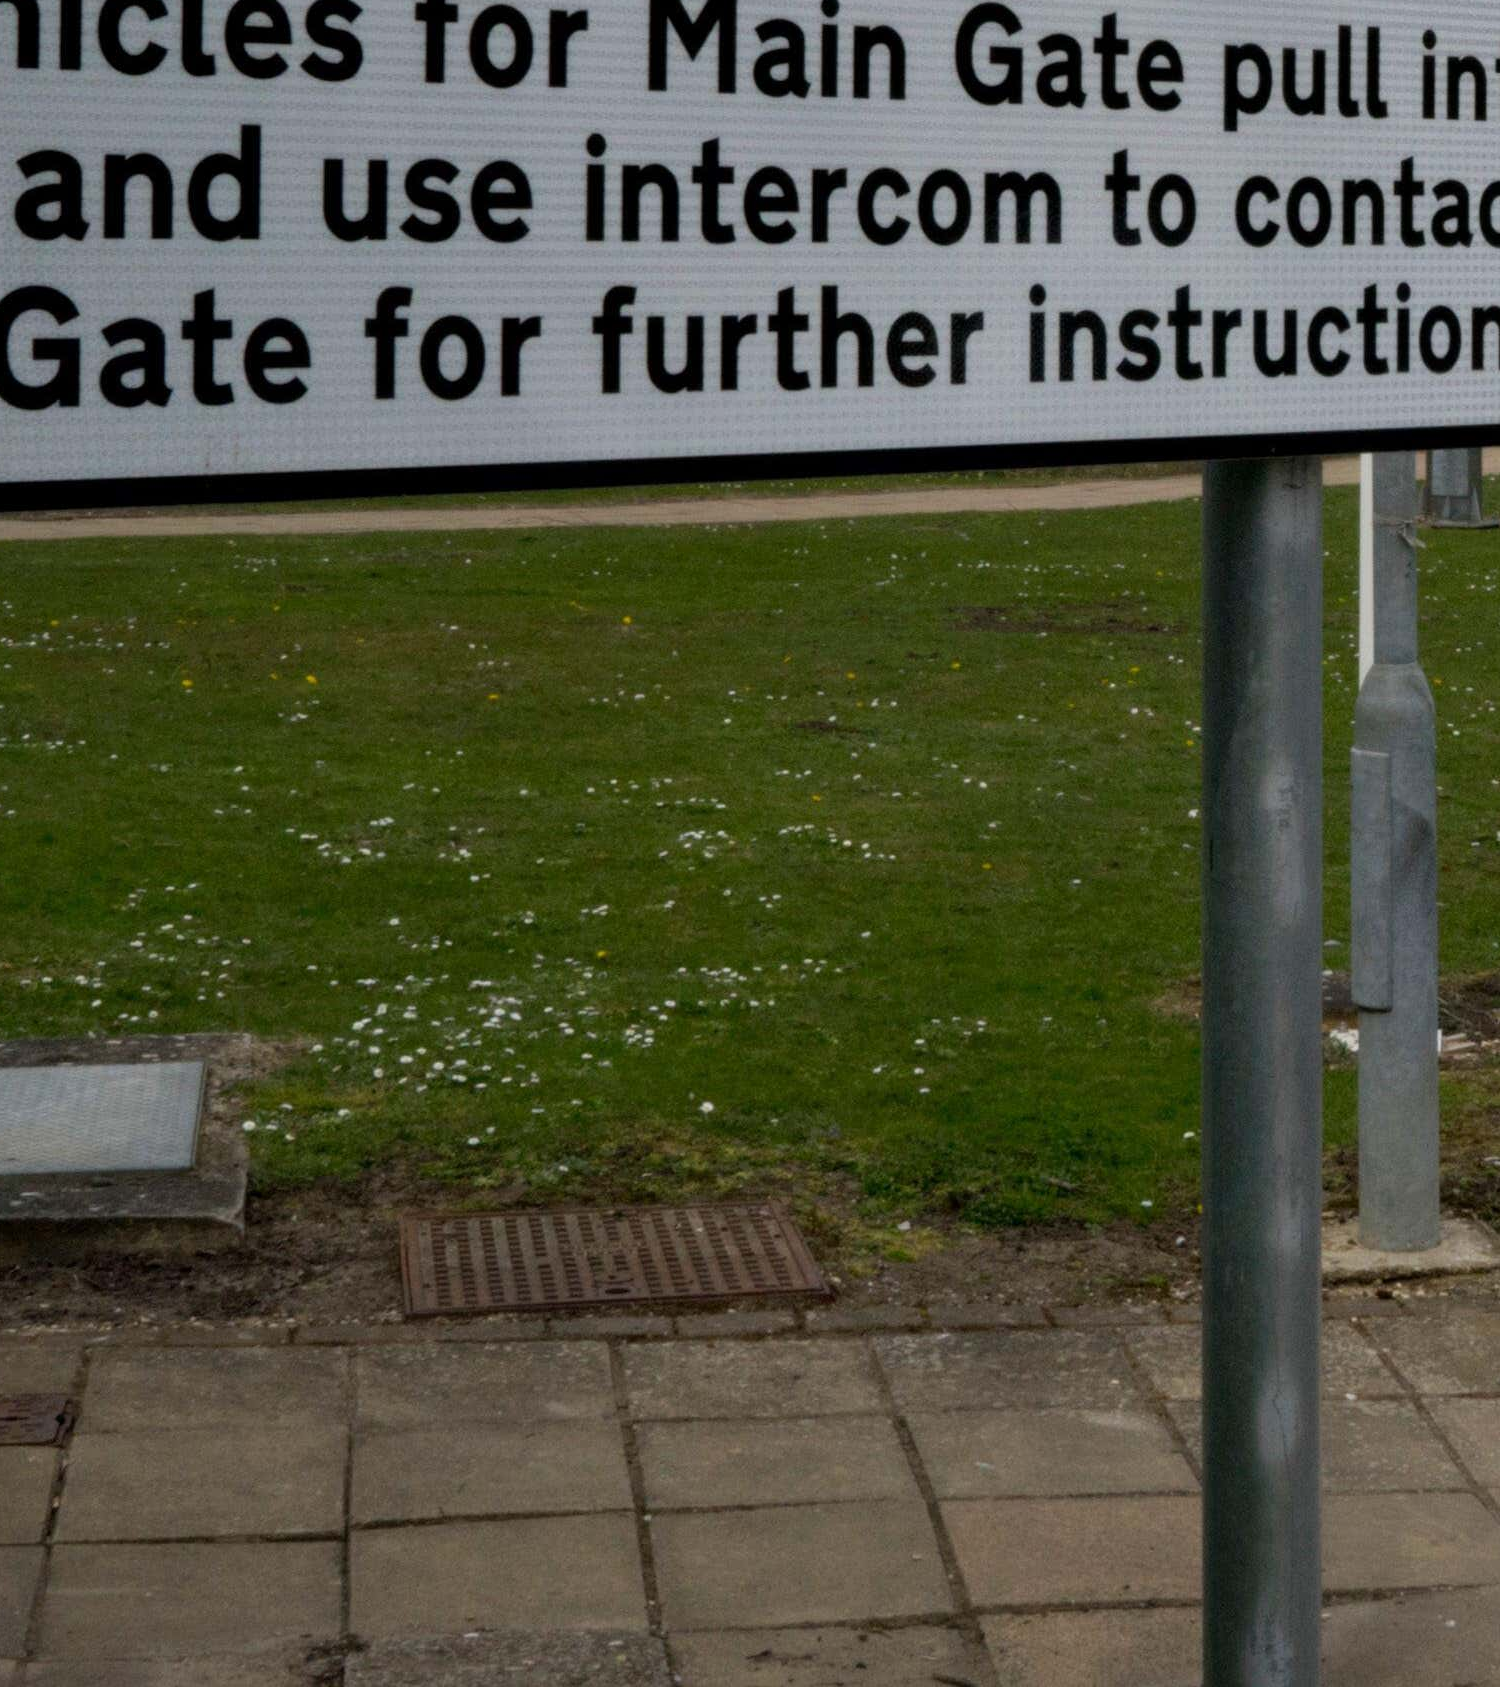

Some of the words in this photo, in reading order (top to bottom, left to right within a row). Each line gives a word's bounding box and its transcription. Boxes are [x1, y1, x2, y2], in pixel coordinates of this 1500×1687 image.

[955, 2, 1183, 111] Gate
[1224, 25, 1387, 131] pull
[14, 124, 261, 242] and
[323, 158, 532, 243] use
[585, 133, 1061, 245] intercom
[1105, 151, 1196, 246] to
[365, 286, 541, 400] for
[593, 286, 983, 395] further
